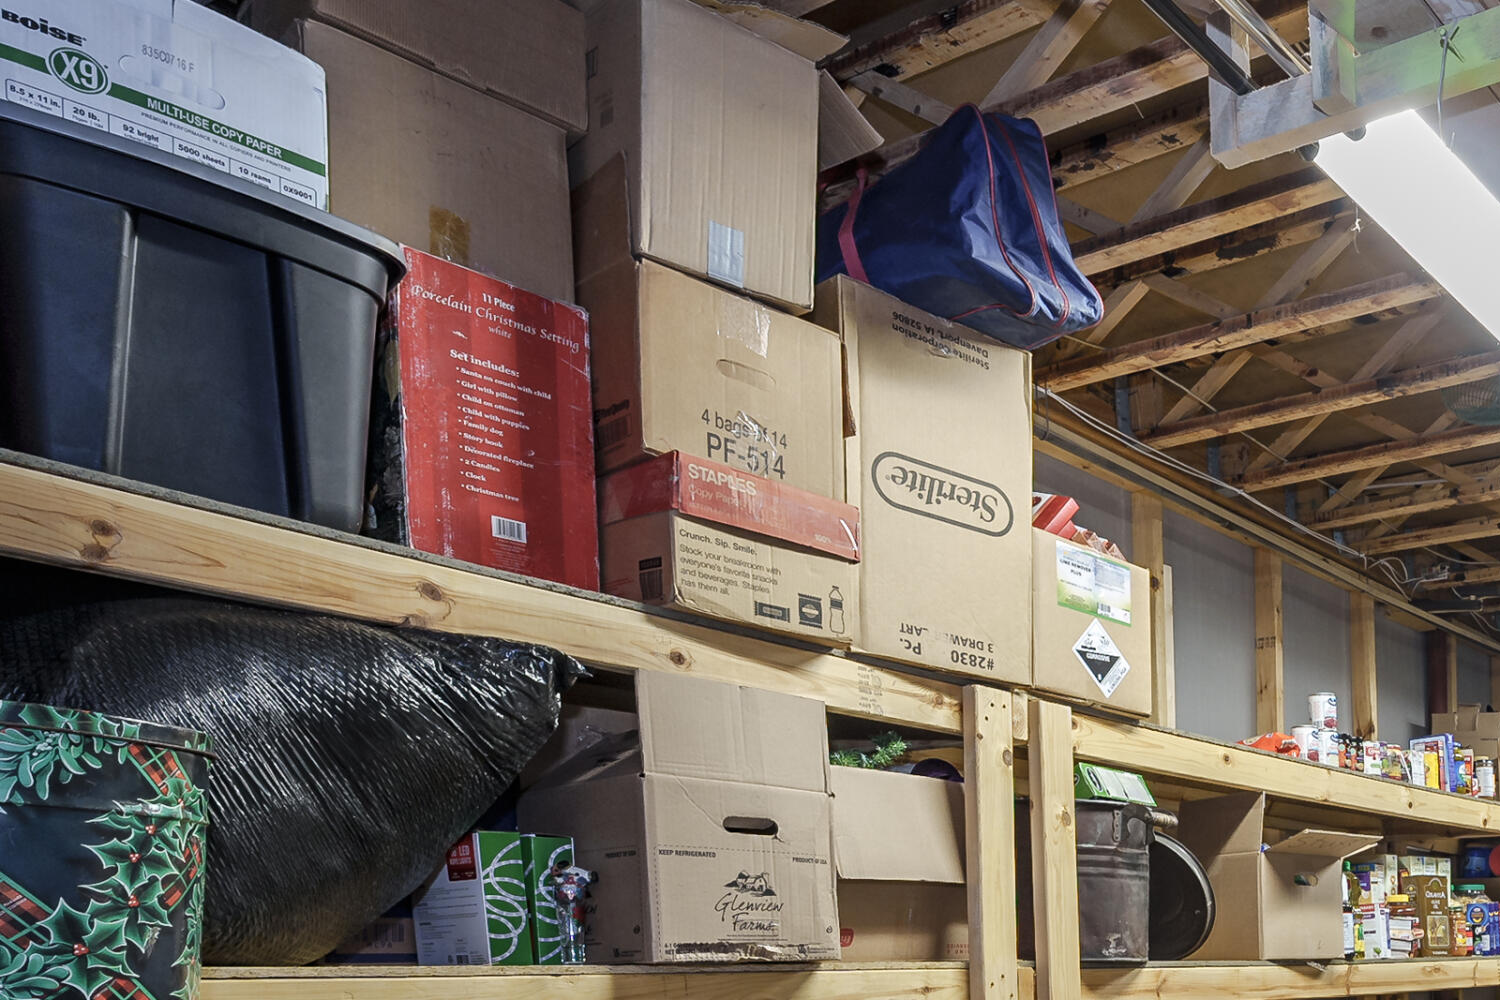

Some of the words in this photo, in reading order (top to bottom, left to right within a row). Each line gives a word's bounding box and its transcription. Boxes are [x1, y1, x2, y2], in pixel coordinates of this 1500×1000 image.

[1, 8, 83, 46] BOISE
[72, 106, 86, 118] 20
[147, 97, 209, 128] MULTI-USE
[211, 120, 243, 144] COPY
[245, 134, 282, 159] PAPER
[169, 121, 209, 143] PERFORMANCE
[178, 143, 200, 158] 5000
[494, 298, 516, 312] Piece
[411, 284, 472, 314] Porcelain
[475, 306, 536, 335] Christmas
[539, 328, 580, 353] Setting
[488, 325, 512, 339] white
[891, 323, 951, 355] Corporation
[450, 349, 469, 363] Set
[470, 352, 520, 378] includes:
[951, 349, 990, 370] Sterilite
[460, 367, 483, 381] Santa
[494, 377, 516, 390] couch
[517, 384, 533, 396] with
[533, 388, 552, 401] child
[461, 379, 476, 391] Girl
[476, 384, 494, 396] with
[495, 389, 518, 403] pillow
[461, 392, 482, 406] Child
[494, 401, 525, 417] ottoman
[462, 406, 484, 418] Child
[484, 411, 500, 424] with
[501, 416, 530, 432] puppies
[463, 418, 489, 434] Family
[489, 426, 504, 438] dog
[701, 408, 710, 425] 4
[715, 411, 752, 439] bags
[773, 430, 788, 449] 14
[463, 431, 484, 446] Story
[484, 436, 504, 449] book
[464, 444, 502, 462] Decorated
[503, 453, 534, 470] fireplace
[471, 459, 501, 473] Candles
[706, 431, 786, 479] PF-514
[465, 470, 487, 483] Clock
[688, 463, 757, 496] STAPLES
[465, 483, 504, 499] Christmas
[504, 492, 520, 502] tree
[890, 464, 999, 524] Sterilite
[679, 528, 713, 545] Crunch.
[714, 537, 731, 551] Sip.
[732, 541, 758, 556] Smile.
[679, 543, 703, 558] Stock
[704, 551, 722, 564] your
[723, 555, 765, 573] breakroom
[766, 566, 782, 577] with
[679, 557, 722, 574] everyone's
[723, 565, 750, 580] favorite
[751, 573, 778, 586] snacks
[680, 567, 697, 578] and
[741, 580, 770, 595] Staples
[681, 577, 697, 588] has
[698, 581, 718, 594] them
[900, 638, 922, 655] Pc.
[950, 650, 995, 671] #2830
[658, 849, 674, 857] KEEP
[674, 850, 717, 859] REFRIGERATED
[714, 892, 784, 922] Glenview
